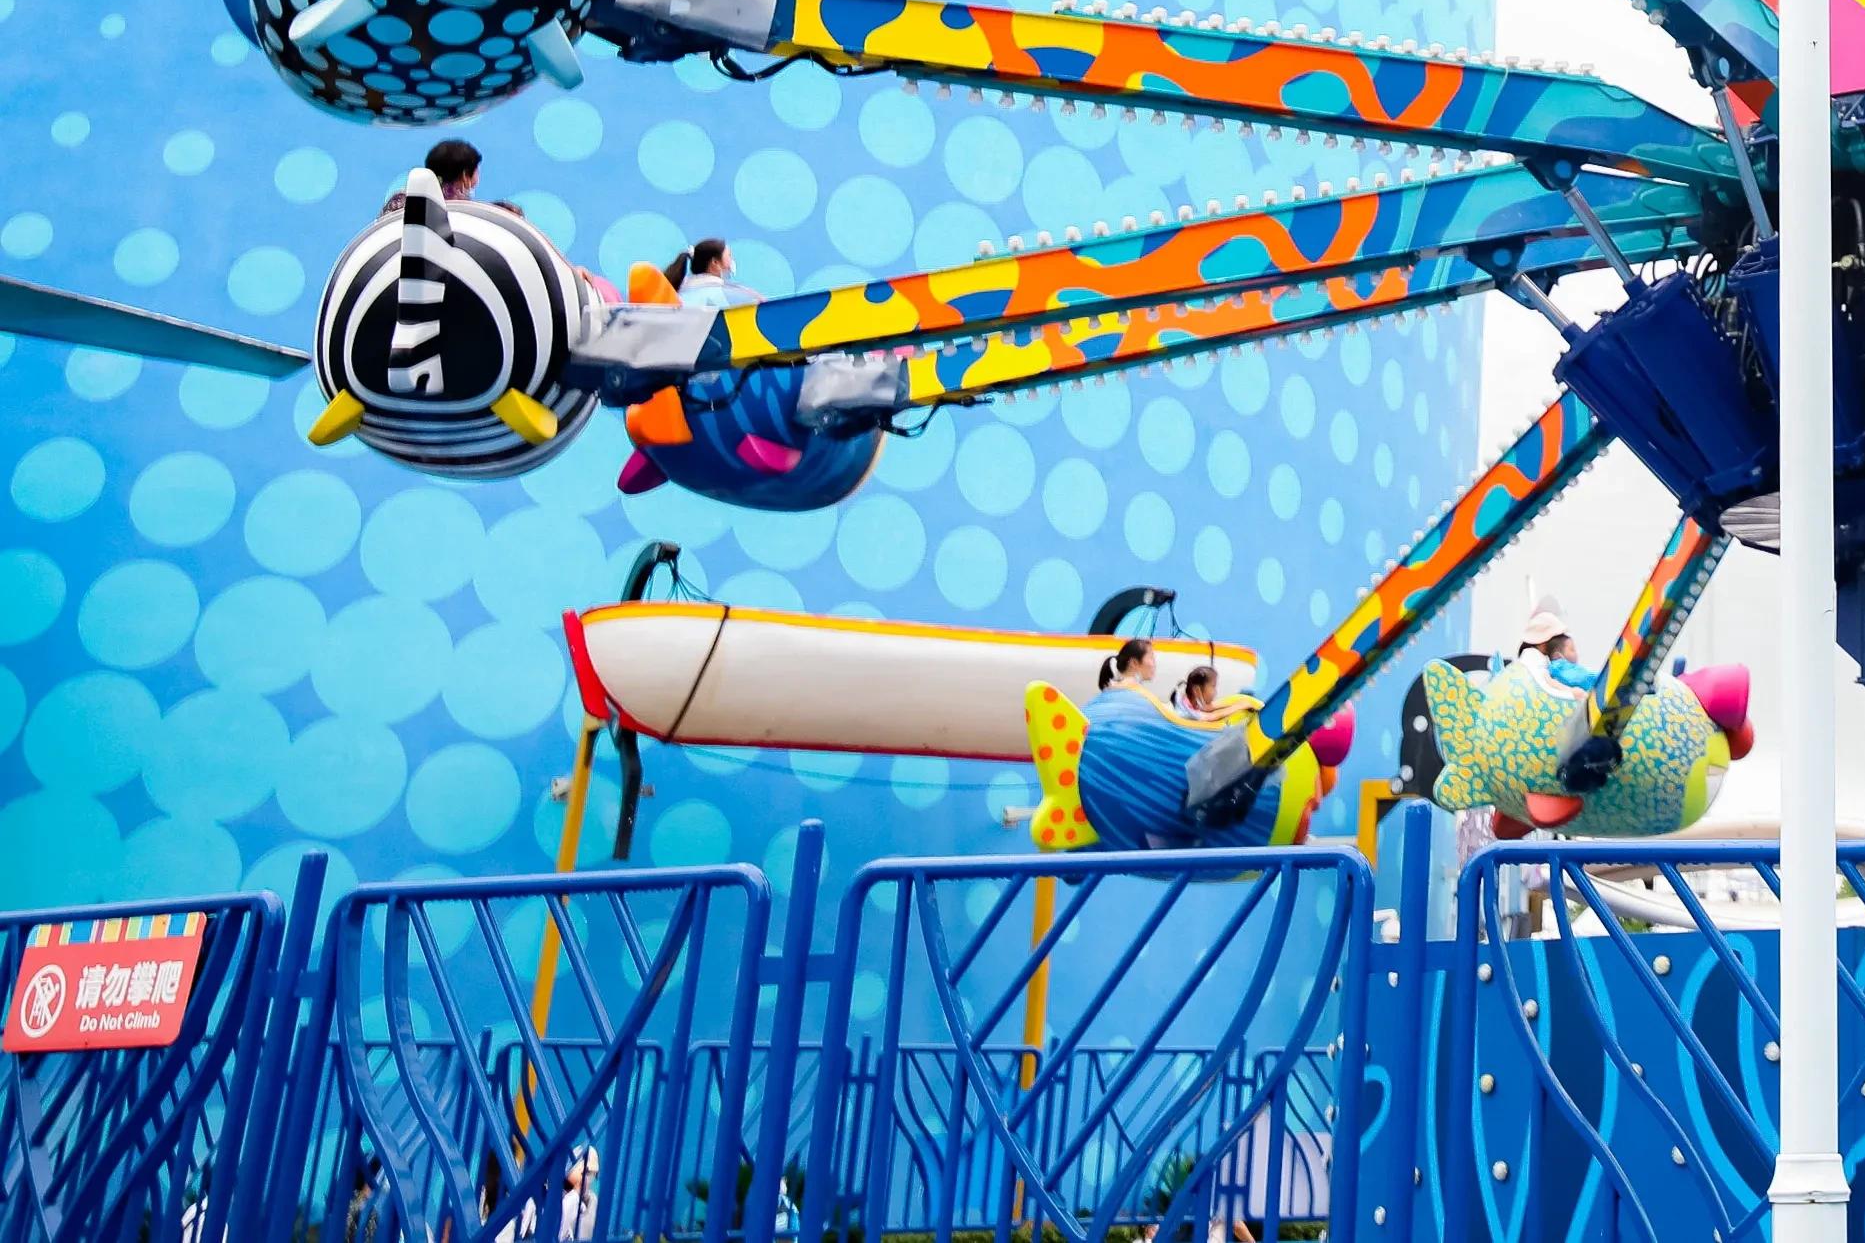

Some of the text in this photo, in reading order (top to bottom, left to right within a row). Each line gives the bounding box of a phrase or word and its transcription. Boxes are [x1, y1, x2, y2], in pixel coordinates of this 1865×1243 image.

[75, 959, 184, 1009] 请勿攀爬
[80, 1010, 161, 1032] Do Not Climb
